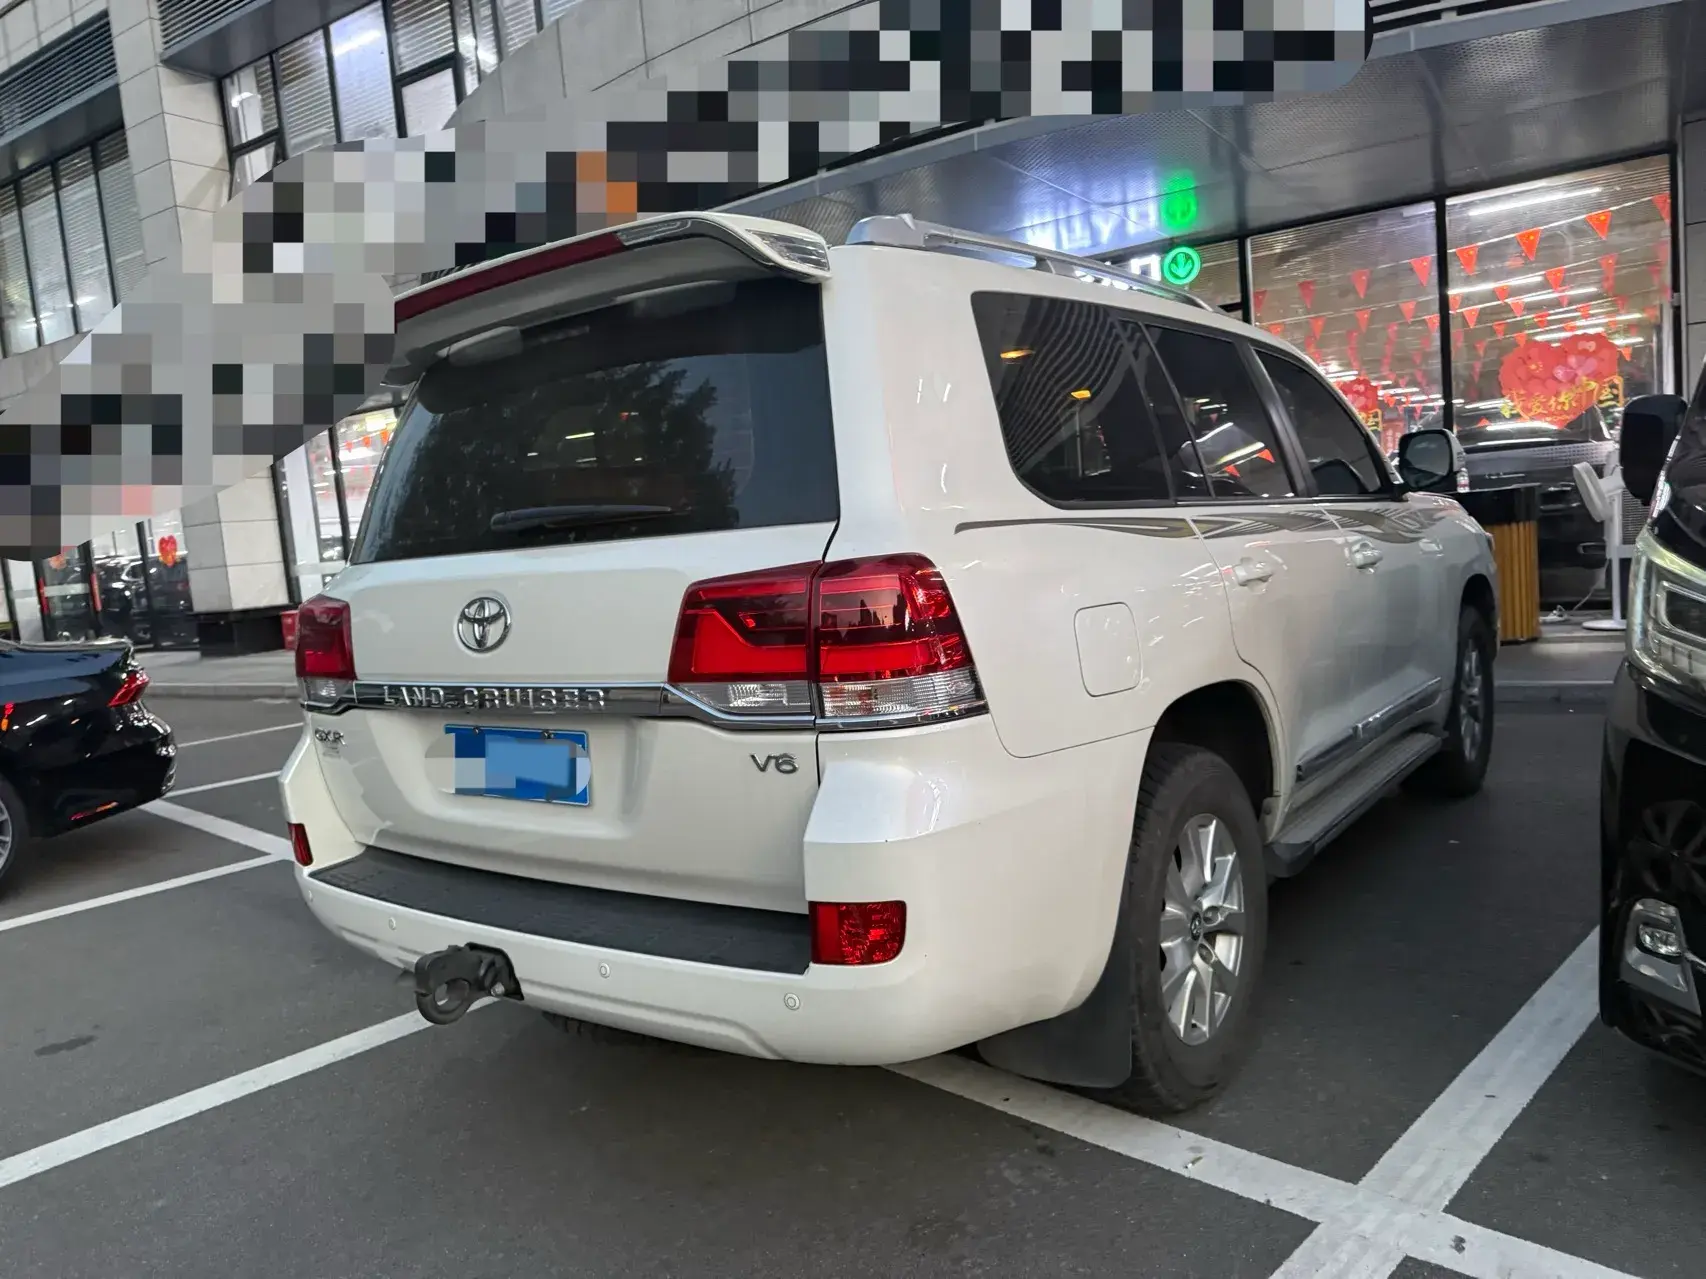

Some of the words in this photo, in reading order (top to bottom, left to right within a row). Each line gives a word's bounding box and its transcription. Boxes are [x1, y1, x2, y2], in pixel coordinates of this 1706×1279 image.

[383, 685, 444, 707] LAND
[463, 687, 604, 710] CRUISER
[749, 752, 799, 775] V6
